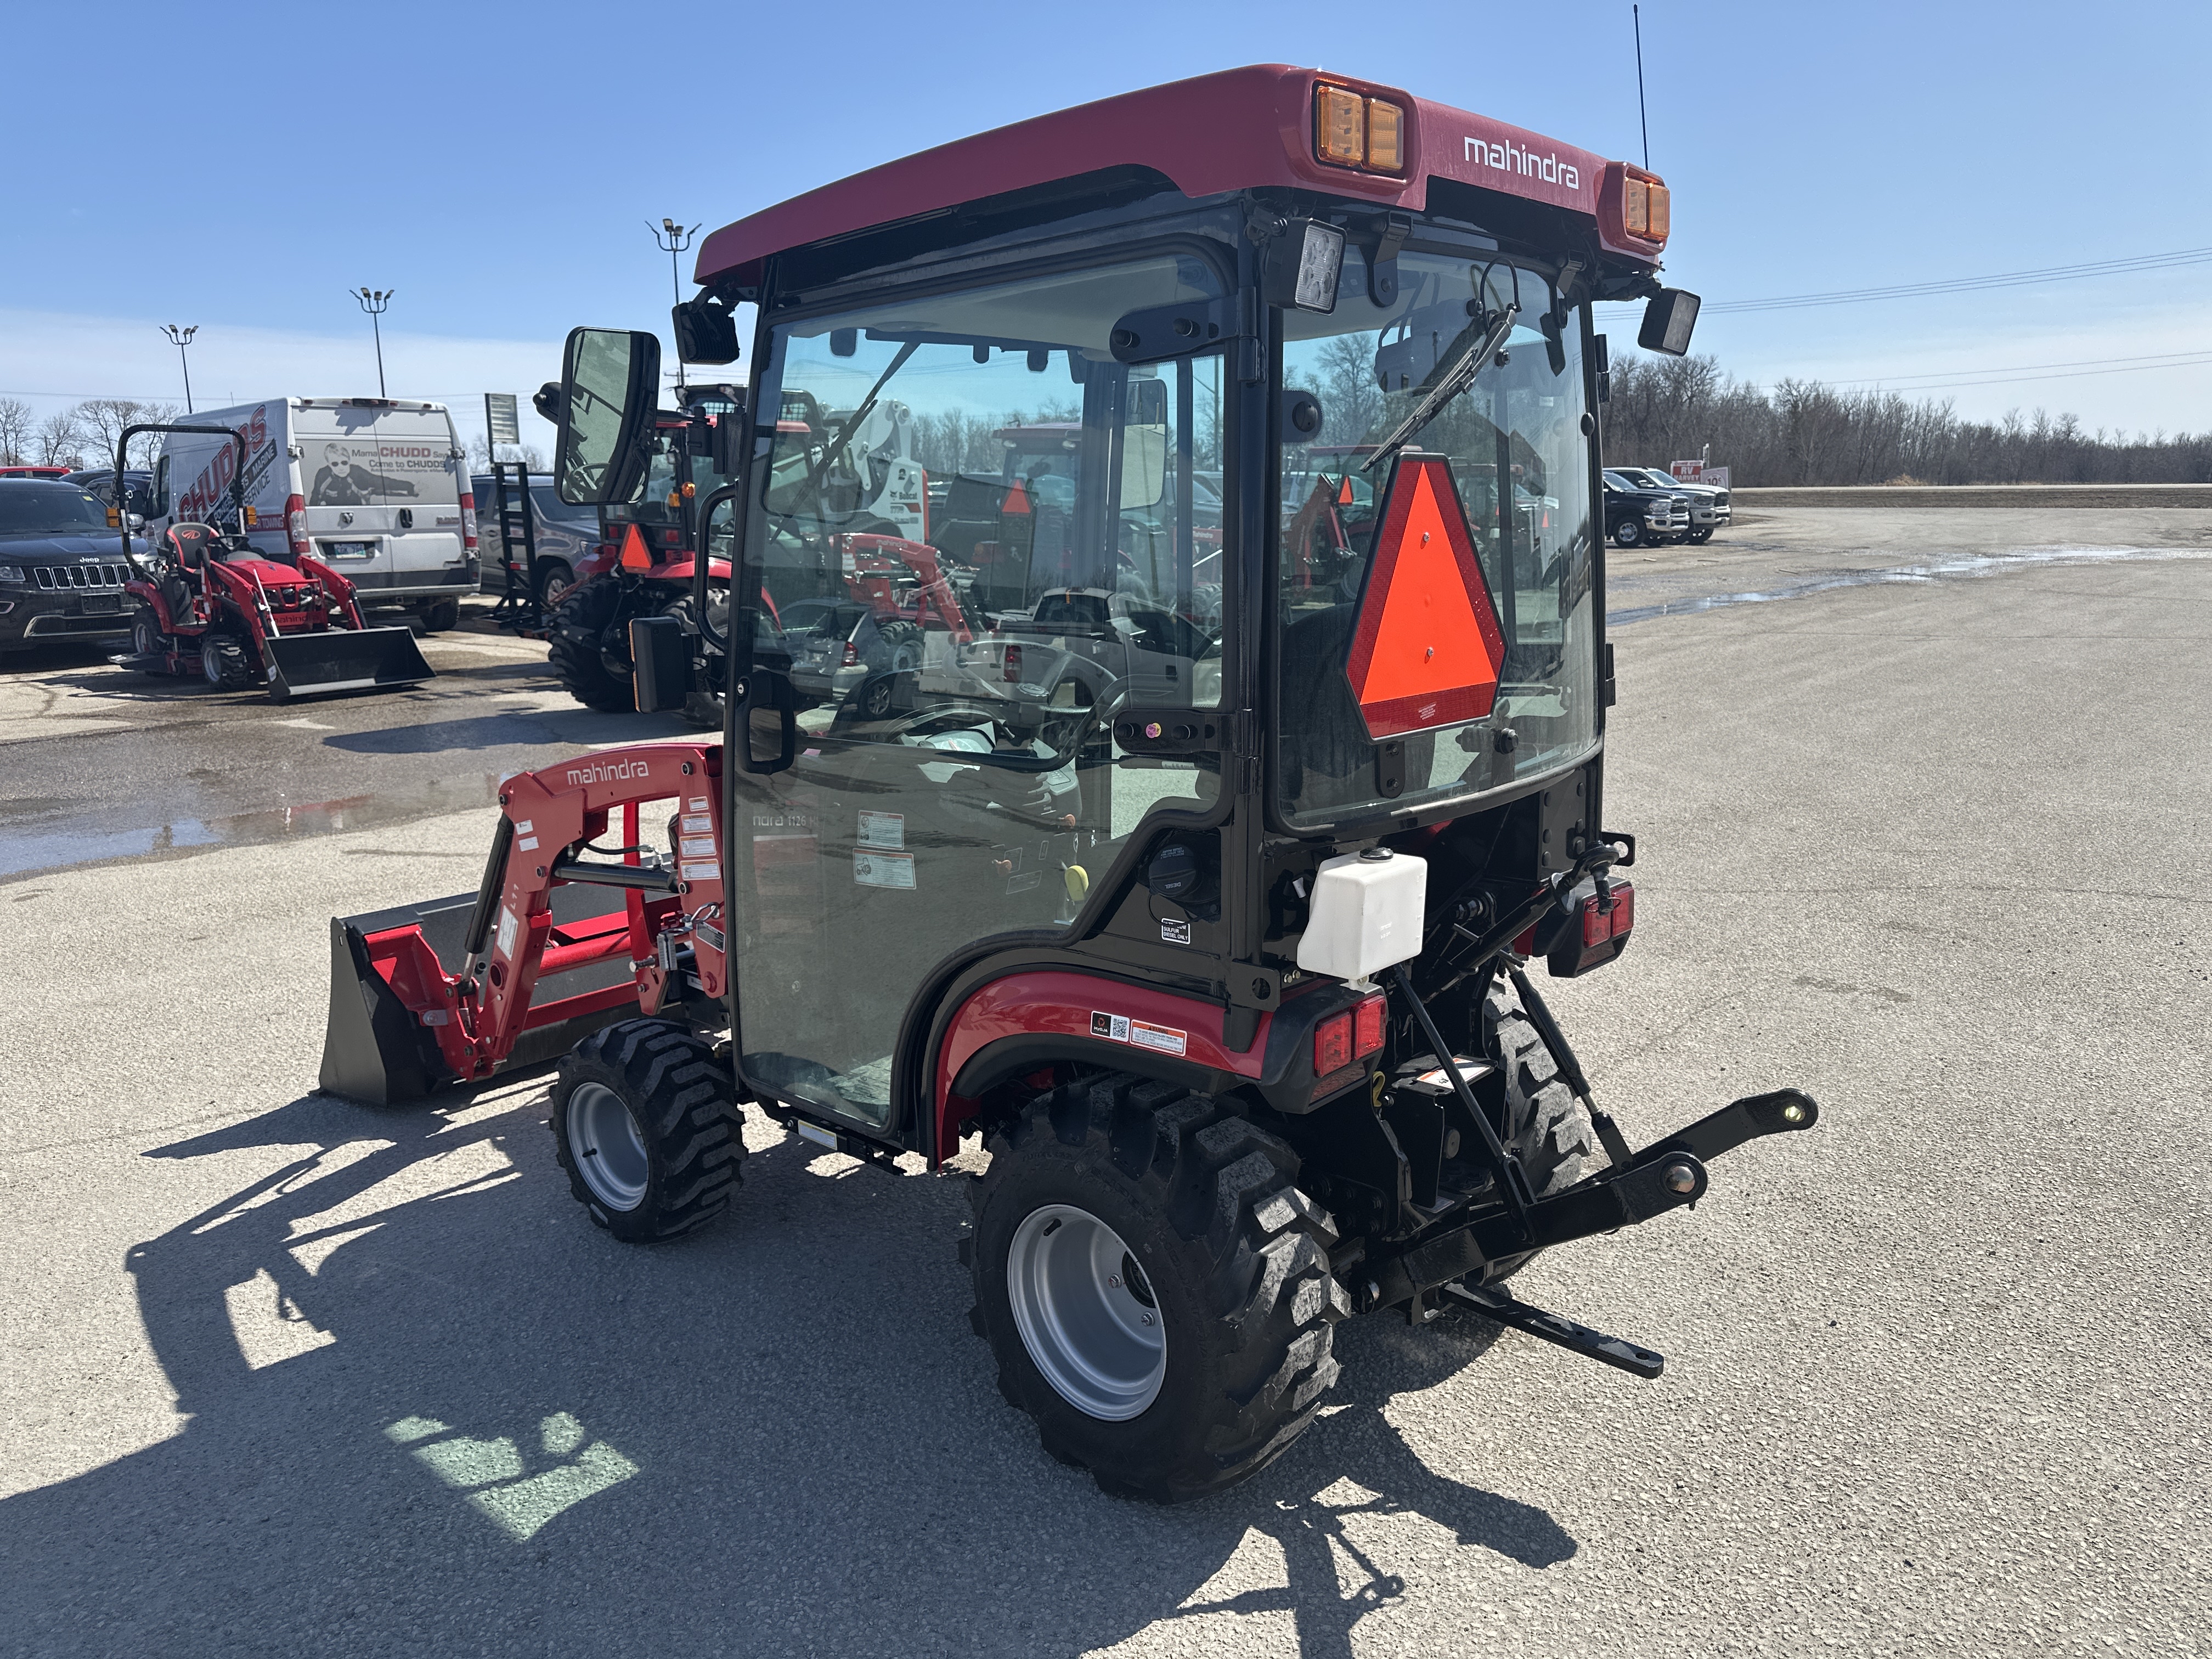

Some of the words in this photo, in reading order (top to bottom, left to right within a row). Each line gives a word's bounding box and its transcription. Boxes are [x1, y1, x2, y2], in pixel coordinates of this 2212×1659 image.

[1464, 137, 1579, 190] mahindra
[380, 447, 431, 458] CHUDD
[433, 451, 449, 459] Say
[252, 444, 275, 476] MARINE
[369, 459, 393, 467] Come
[1680, 466, 1694, 475] RV
[243, 470, 270, 505] SERVICE
[261, 517, 284, 529] TOWING
[567, 758, 649, 785] mahindra
[788, 815, 806, 826] 1126
